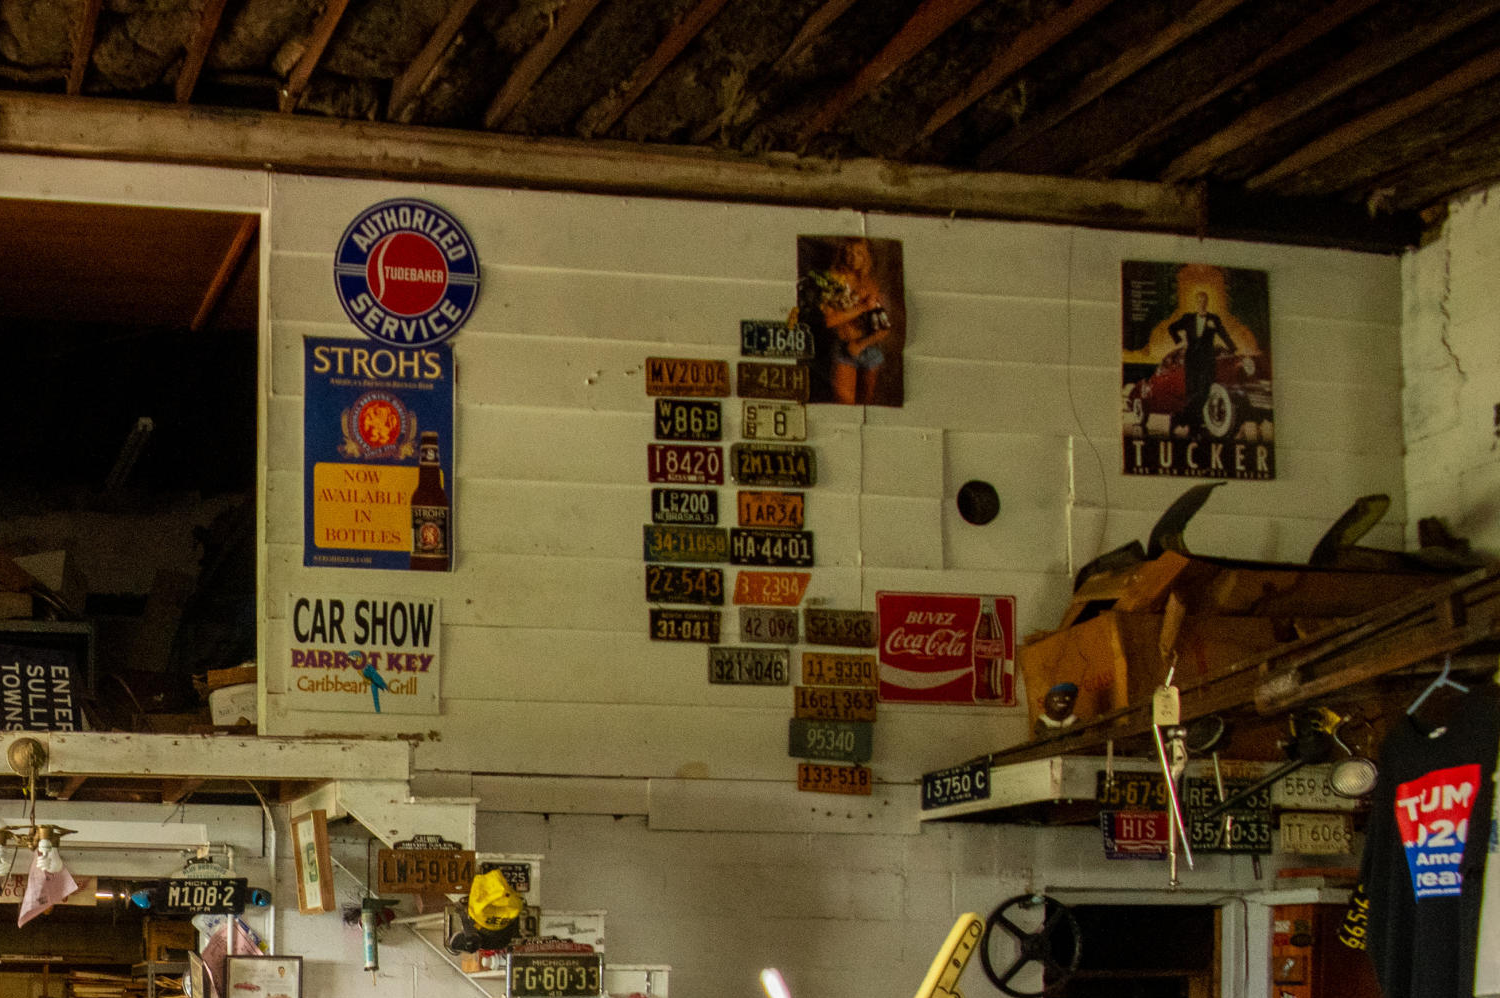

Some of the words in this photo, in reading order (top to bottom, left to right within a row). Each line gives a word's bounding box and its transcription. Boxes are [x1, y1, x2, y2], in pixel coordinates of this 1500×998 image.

[351, 206, 467, 262] AUTHORIZED
[351, 292, 462, 341] SERVICE
[313, 346, 442, 380] STROH'S
[1132, 440, 1269, 472] TUCKER
[344, 468, 382, 484] NOW
[318, 487, 408, 506] AVAILABLE
[354, 509, 371, 524] IN
[325, 527, 401, 544] BOTTLES
[293, 597, 347, 644] CAR
[354, 599, 434, 648] SHOW
[905, 611, 957, 626] BUVEZ
[291, 649, 382, 672] PARROT
[386, 651, 436, 674] KEY
[297, 674, 369, 695] Caribbean
[388, 676, 418, 696] Grill
